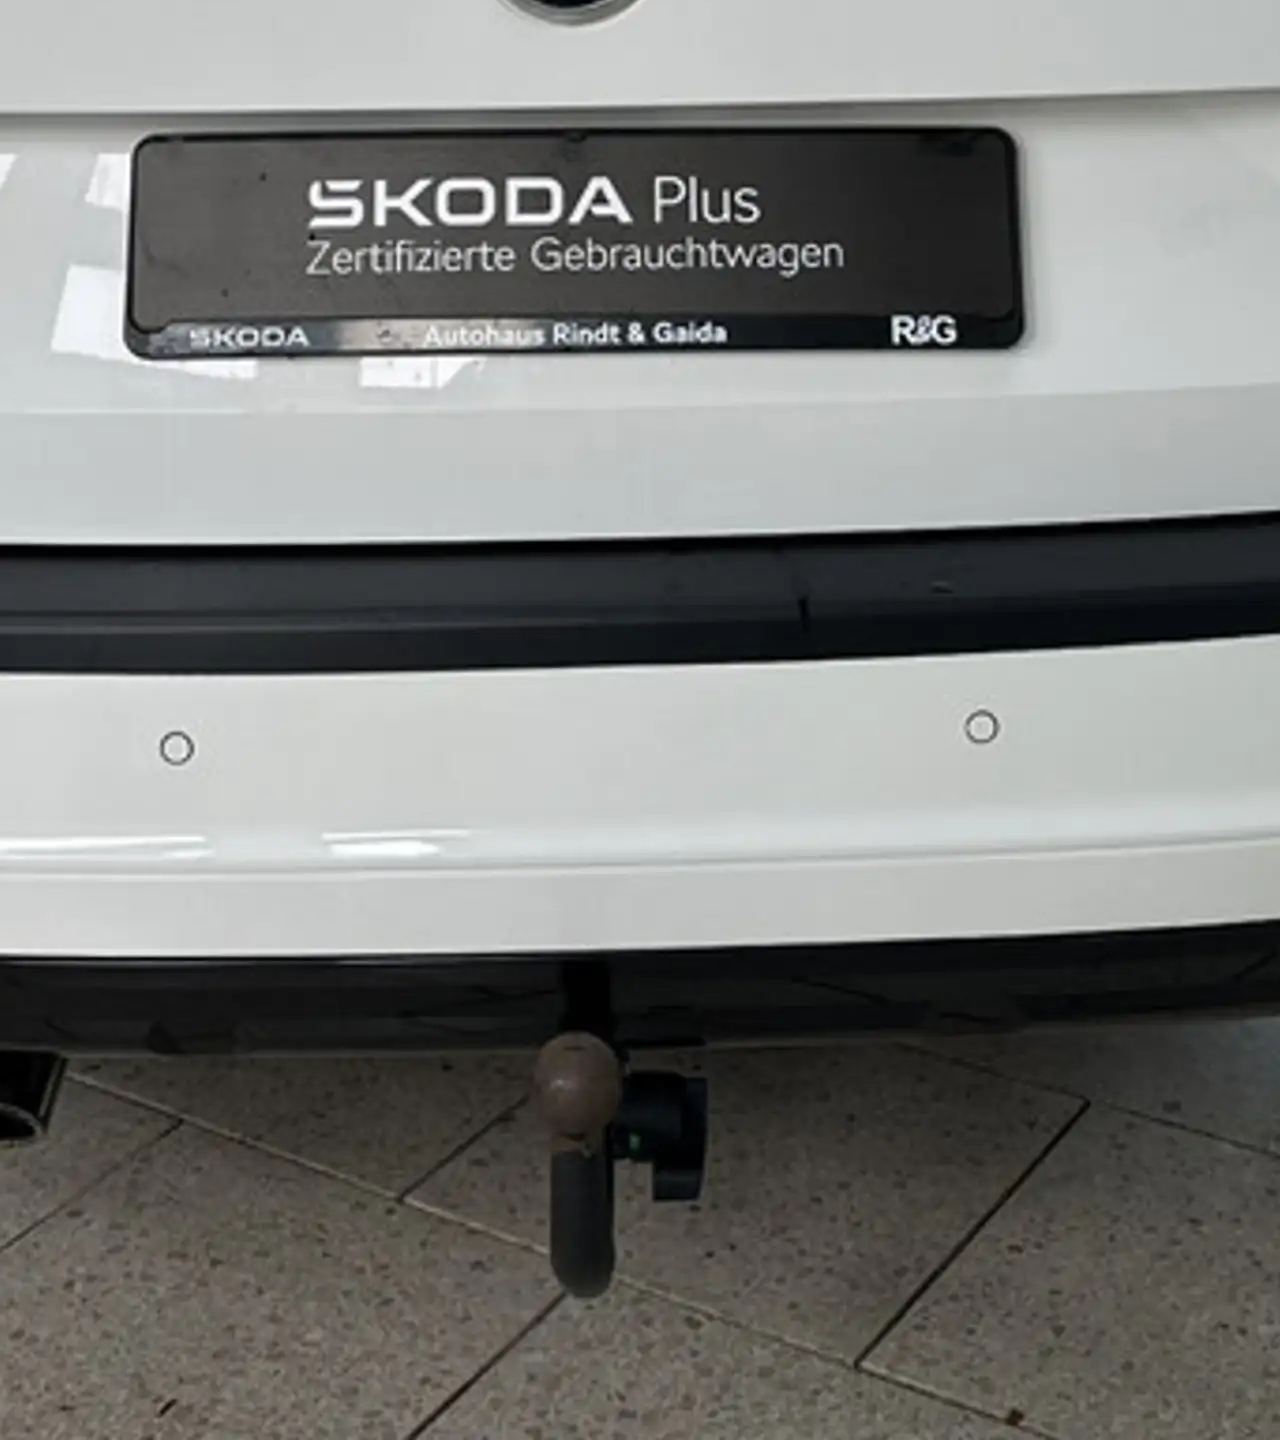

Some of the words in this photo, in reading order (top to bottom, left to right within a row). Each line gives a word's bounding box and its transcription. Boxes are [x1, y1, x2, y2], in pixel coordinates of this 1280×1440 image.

[654, 175, 762, 225] Plus
[305, 239, 517, 275] Zertifizierte
[531, 235, 845, 279] Gebrauchtwagen
[423, 323, 547, 348] Autohaus
[552, 321, 622, 346] Rindt
[627, 321, 646, 344] &
[652, 319, 729, 344] Gaida
[890, 314, 958, 346] R&G
